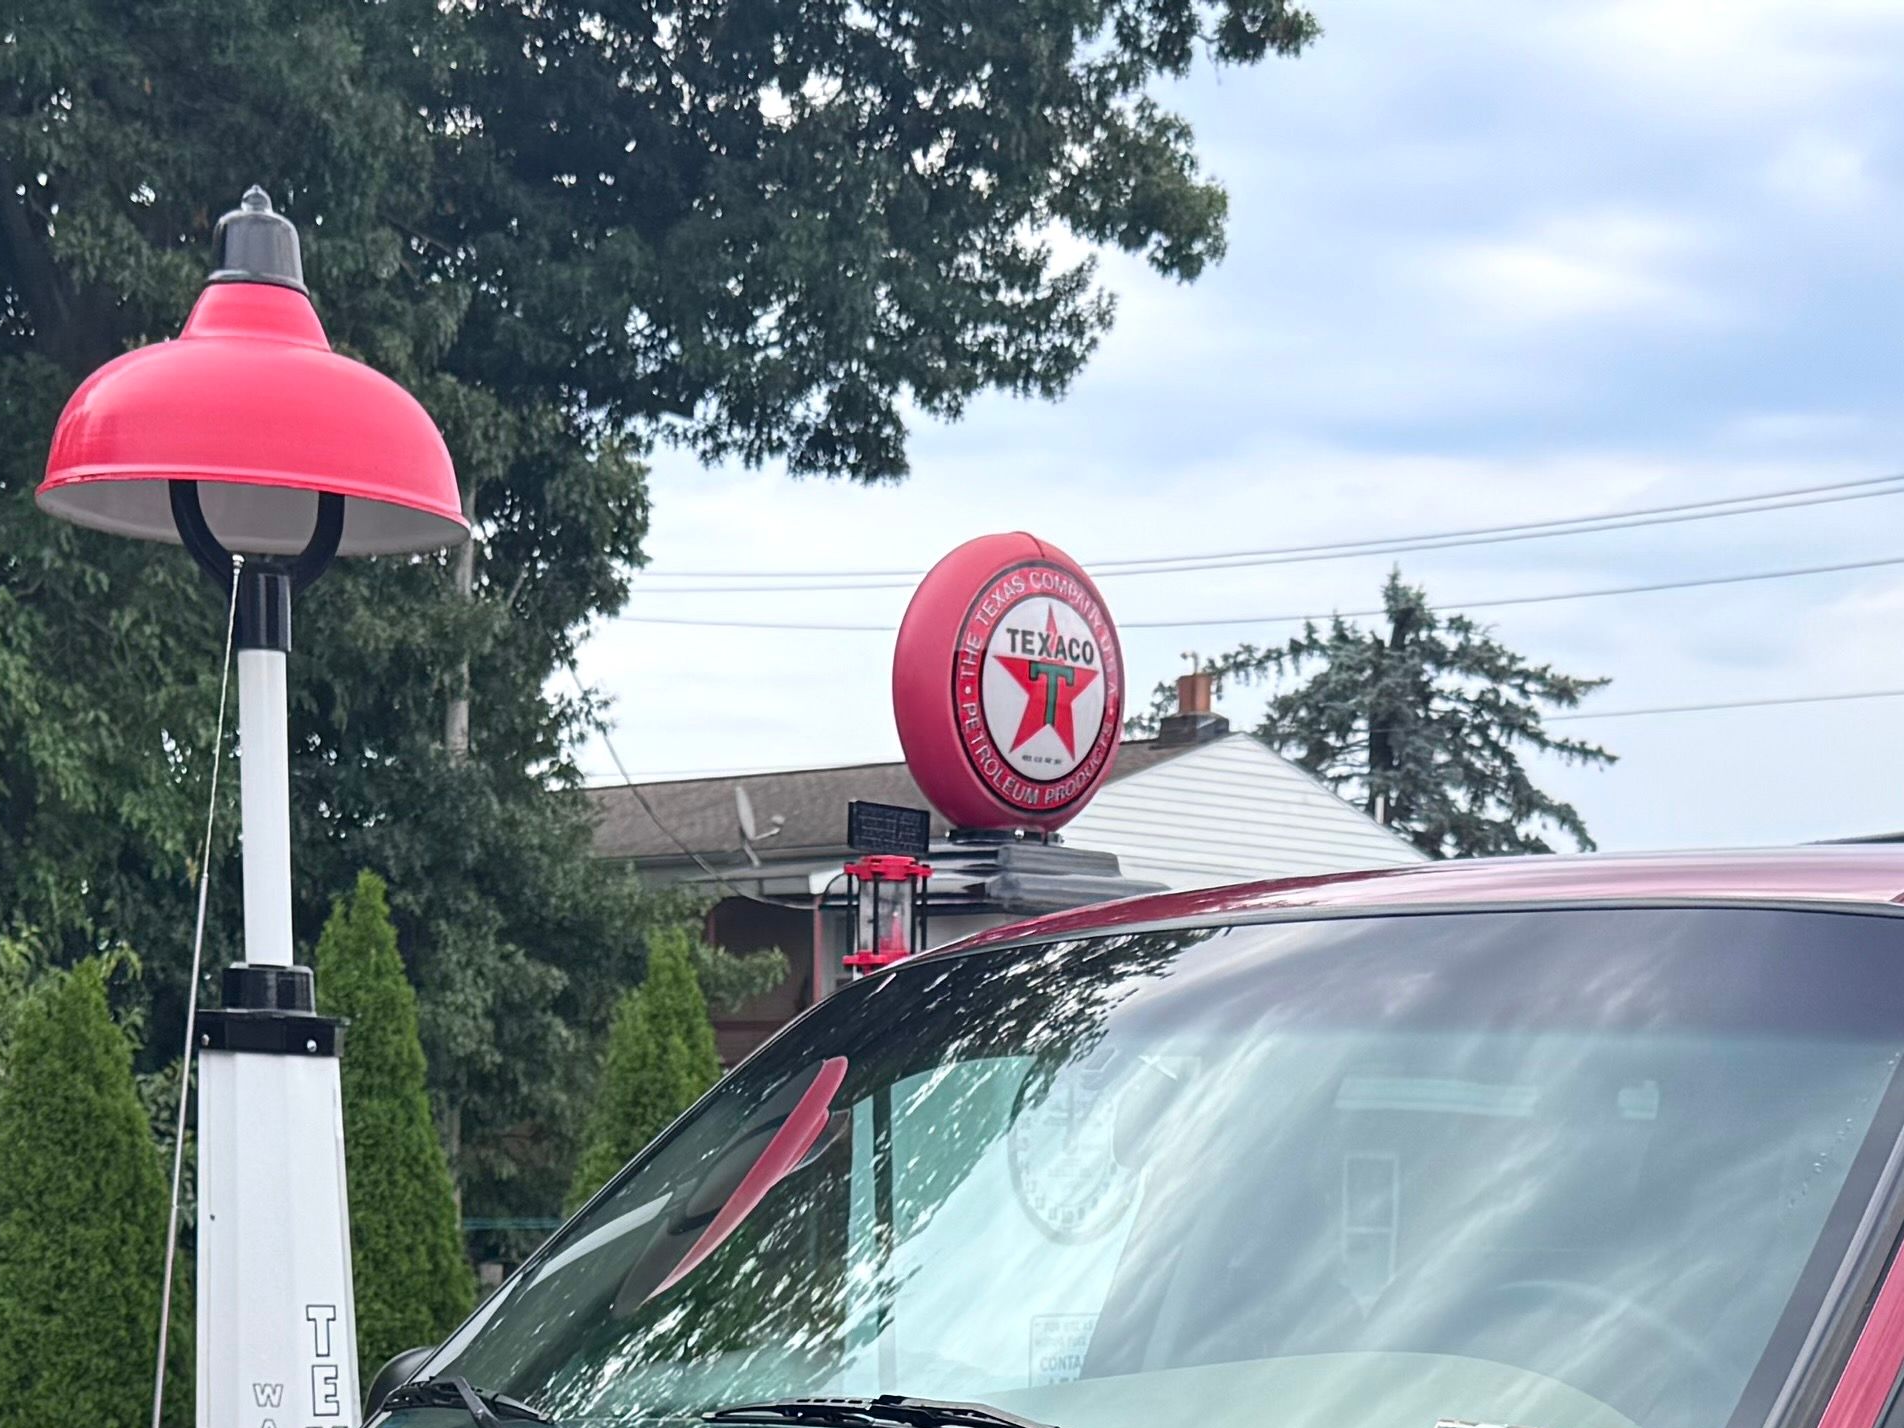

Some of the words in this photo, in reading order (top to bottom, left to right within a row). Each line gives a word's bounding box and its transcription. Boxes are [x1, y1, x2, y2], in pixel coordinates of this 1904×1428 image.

[960, 632, 982, 679] THE
[975, 575, 1025, 626] TEXAS
[1006, 627, 1095, 666] TEXACO
[962, 702, 1040, 805] PETROLEUM
